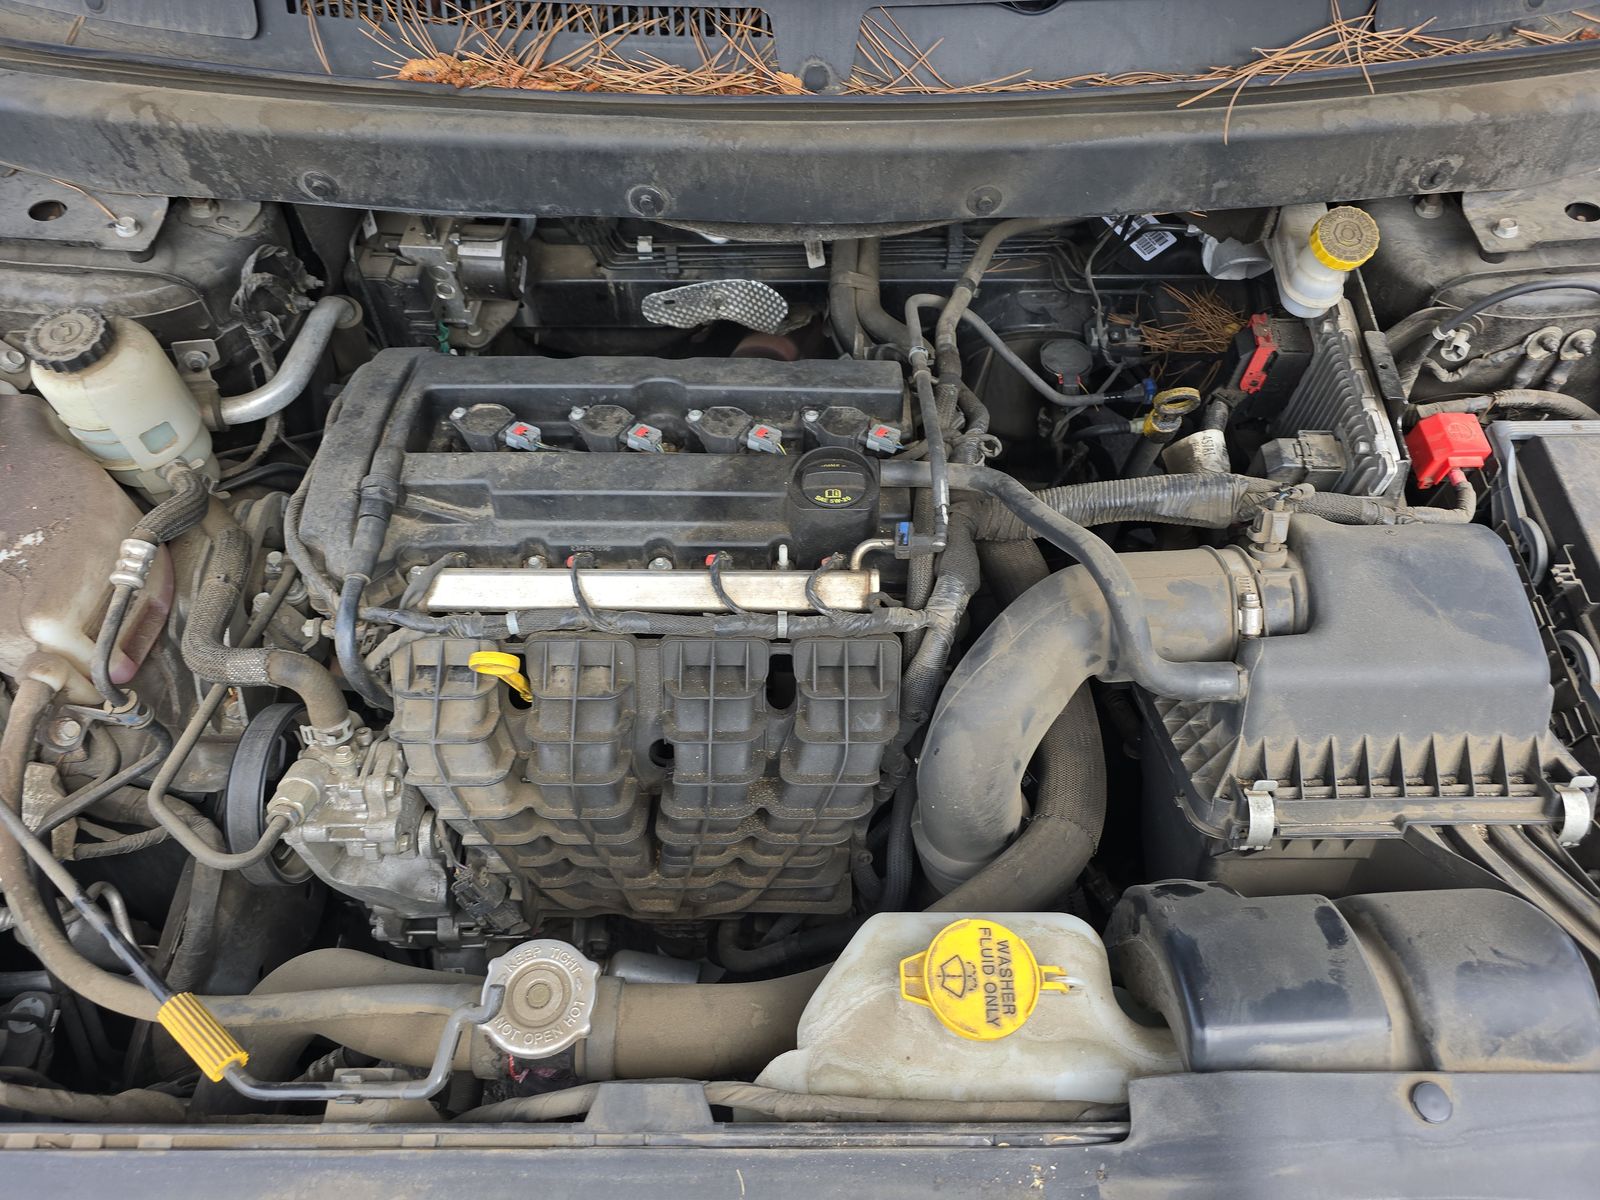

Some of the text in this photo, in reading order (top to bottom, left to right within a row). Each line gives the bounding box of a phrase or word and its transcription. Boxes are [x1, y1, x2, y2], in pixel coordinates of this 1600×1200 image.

[815, 495, 852, 504] SAE 5W-20
[504, 946, 583, 974] KEEP TIGHT
[977, 927, 1001, 1028] FLUID ONLY
[996, 939, 1017, 1016] WASHER
[494, 1001, 585, 1045] NOT OPEN HOT
